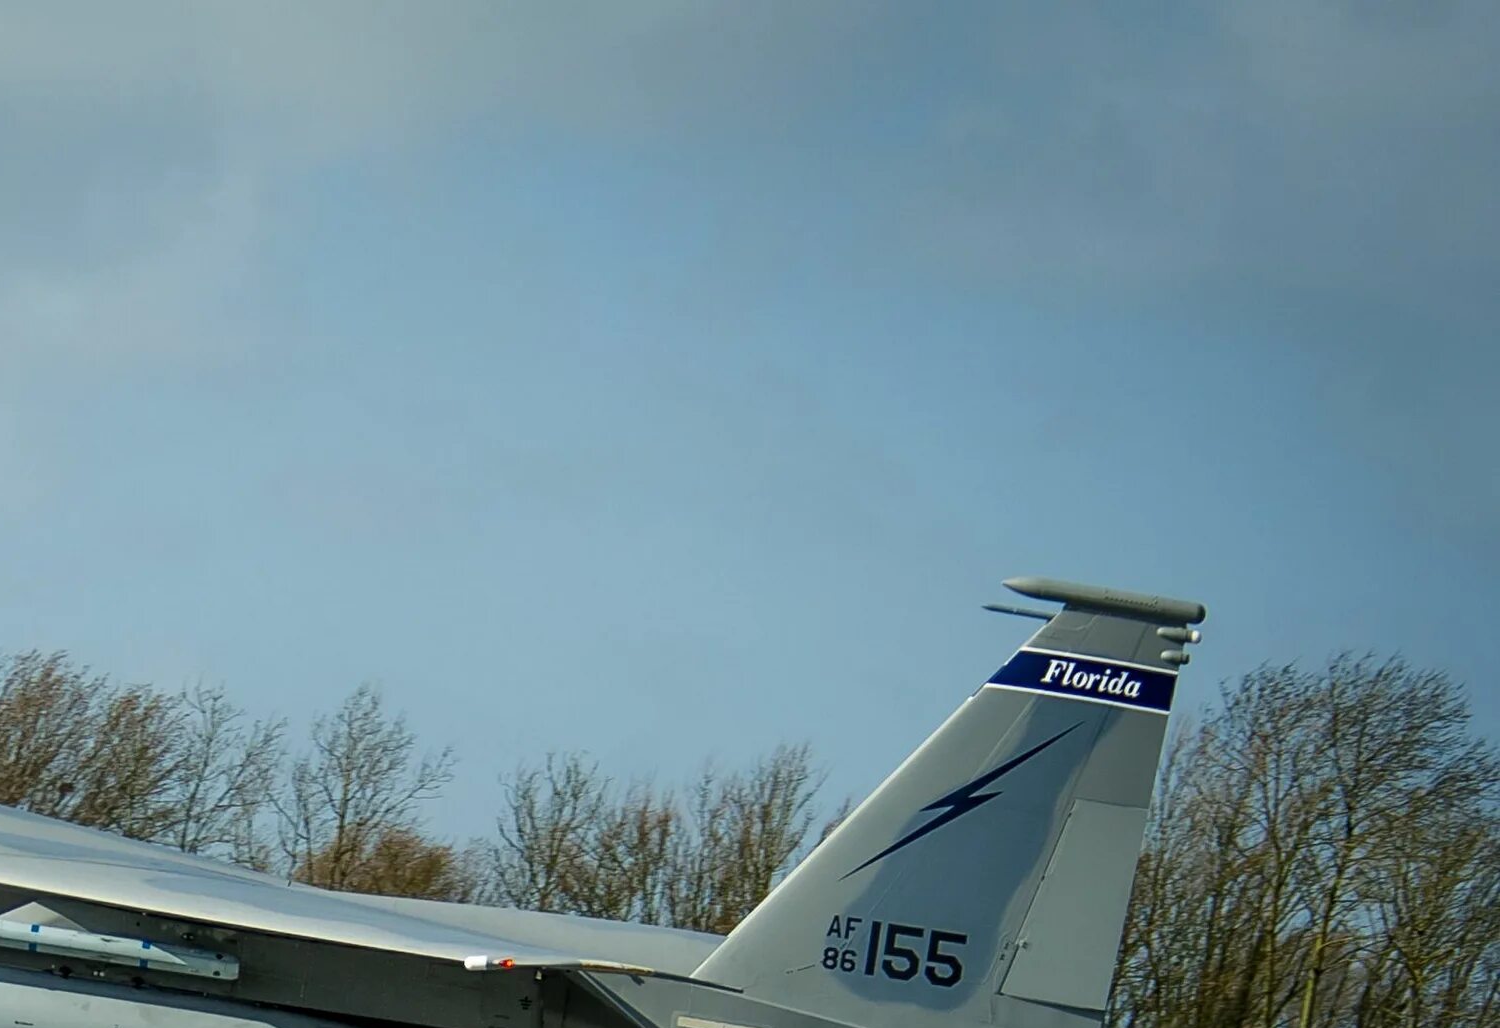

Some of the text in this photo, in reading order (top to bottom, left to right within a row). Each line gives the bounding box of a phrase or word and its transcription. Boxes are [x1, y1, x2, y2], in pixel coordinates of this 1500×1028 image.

[1040, 659, 1142, 698] Florida
[826, 915, 863, 939] AF
[822, 947, 857, 972] 86
[864, 920, 968, 988] 155
